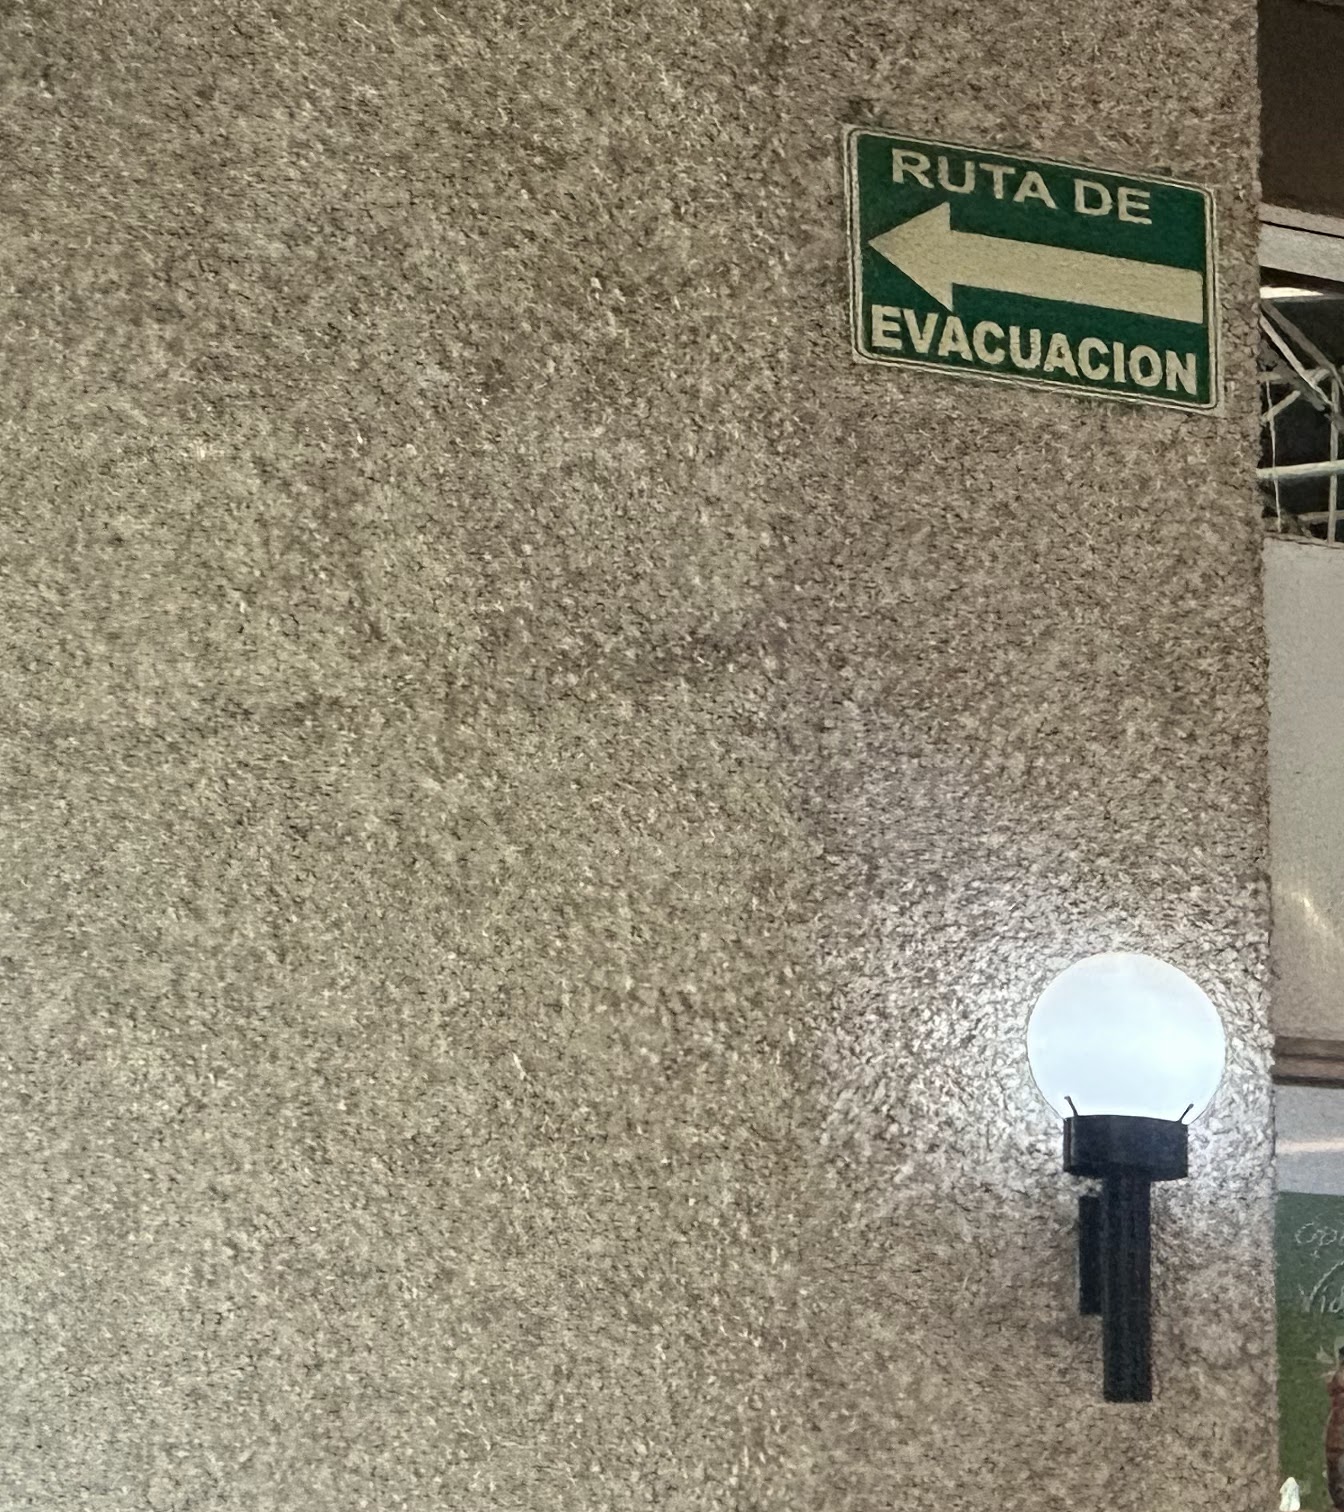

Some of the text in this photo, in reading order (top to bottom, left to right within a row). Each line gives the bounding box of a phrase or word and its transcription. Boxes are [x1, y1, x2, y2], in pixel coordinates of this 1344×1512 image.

[891, 148, 1153, 225] RUTA DE
[870, 304, 1199, 396] EVACUACION
